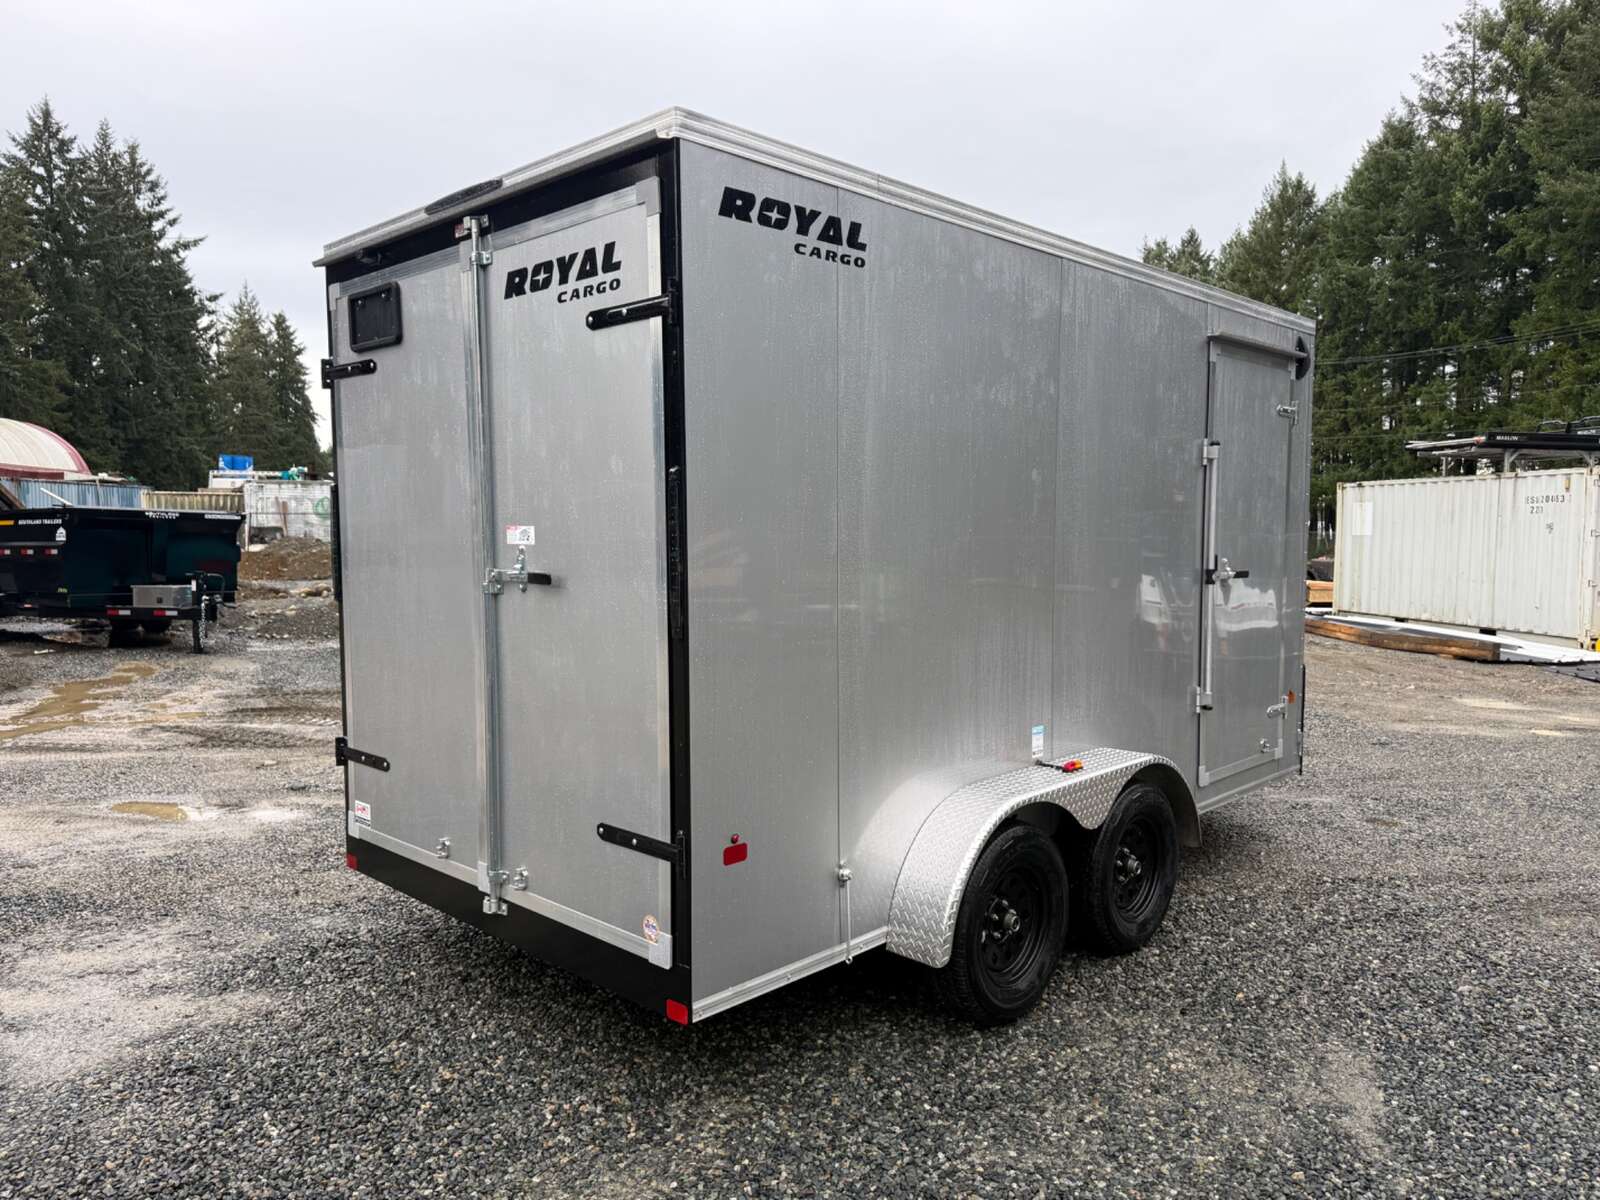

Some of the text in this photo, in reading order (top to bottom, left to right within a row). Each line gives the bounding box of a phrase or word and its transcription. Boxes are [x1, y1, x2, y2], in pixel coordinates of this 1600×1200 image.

[718, 186, 867, 252] ROYAL
[504, 241, 622, 300] ROYAL
[794, 243, 866, 268] CARGO
[557, 278, 621, 303] CARGO
